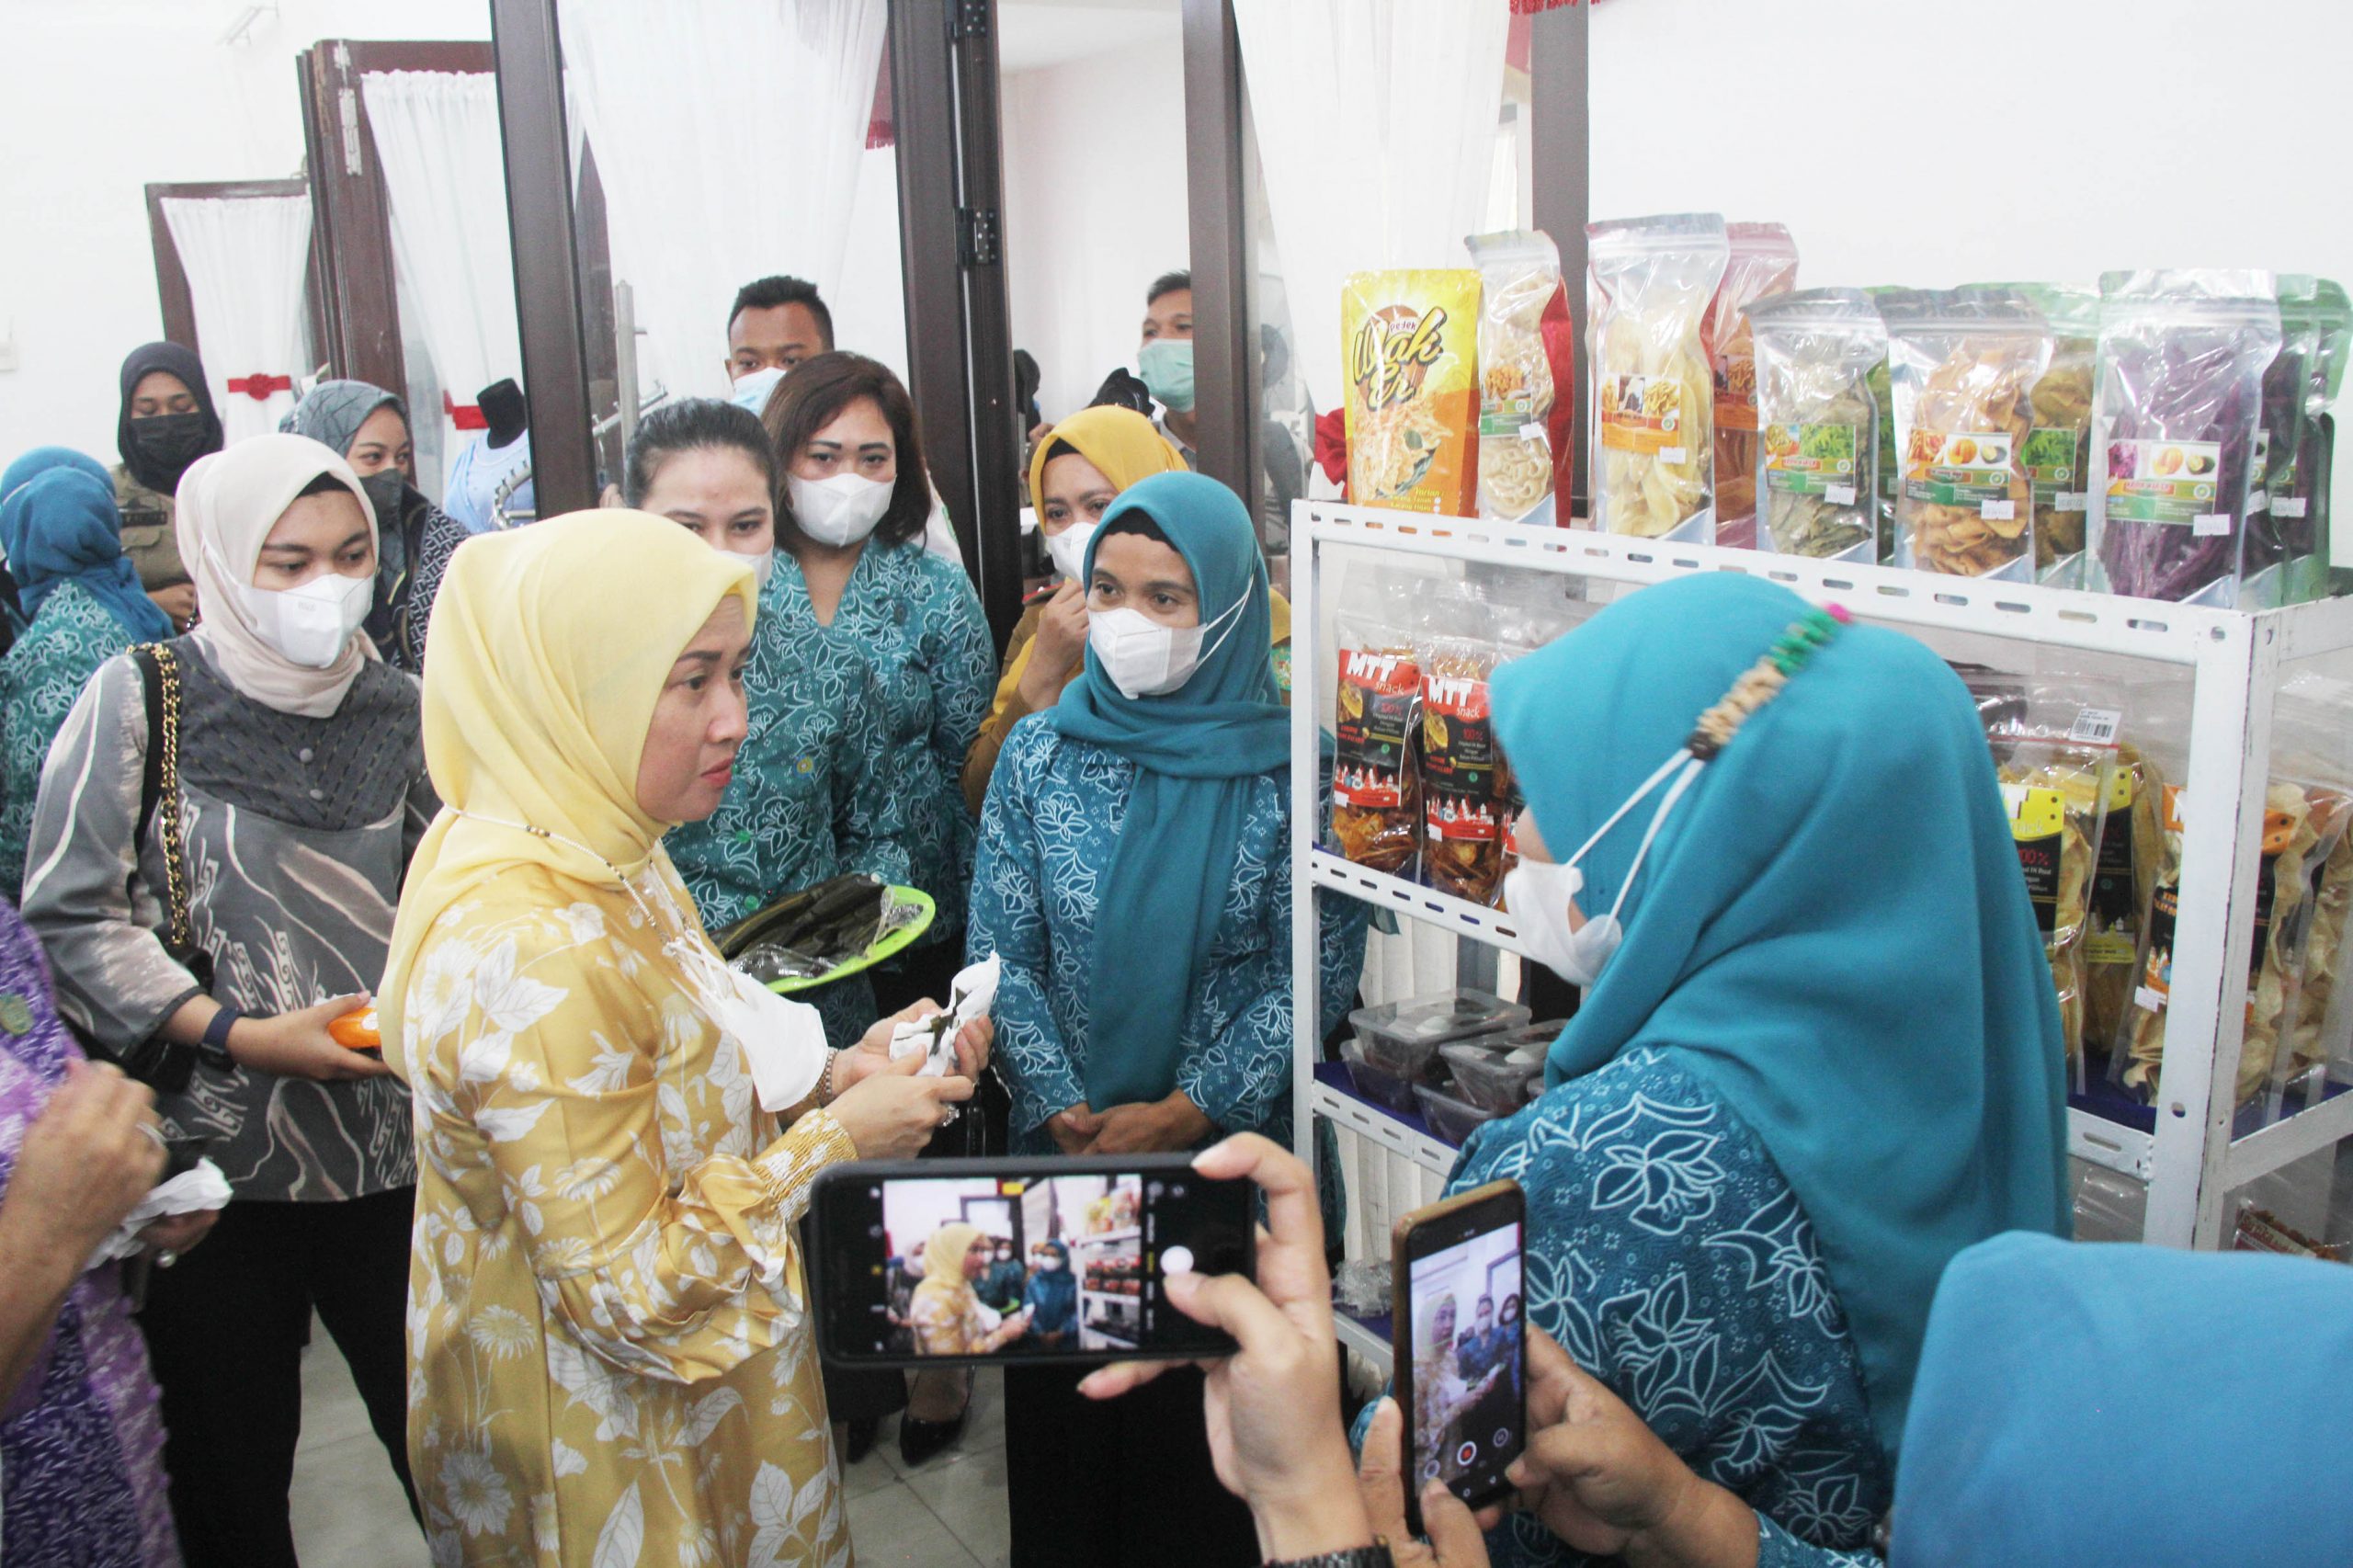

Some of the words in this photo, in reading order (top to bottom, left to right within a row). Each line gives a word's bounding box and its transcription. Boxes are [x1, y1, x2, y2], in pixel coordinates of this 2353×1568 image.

[1346, 651, 1398, 683] MTT
[1428, 676, 1473, 707] MTT
[1456, 704, 1480, 720] snack
